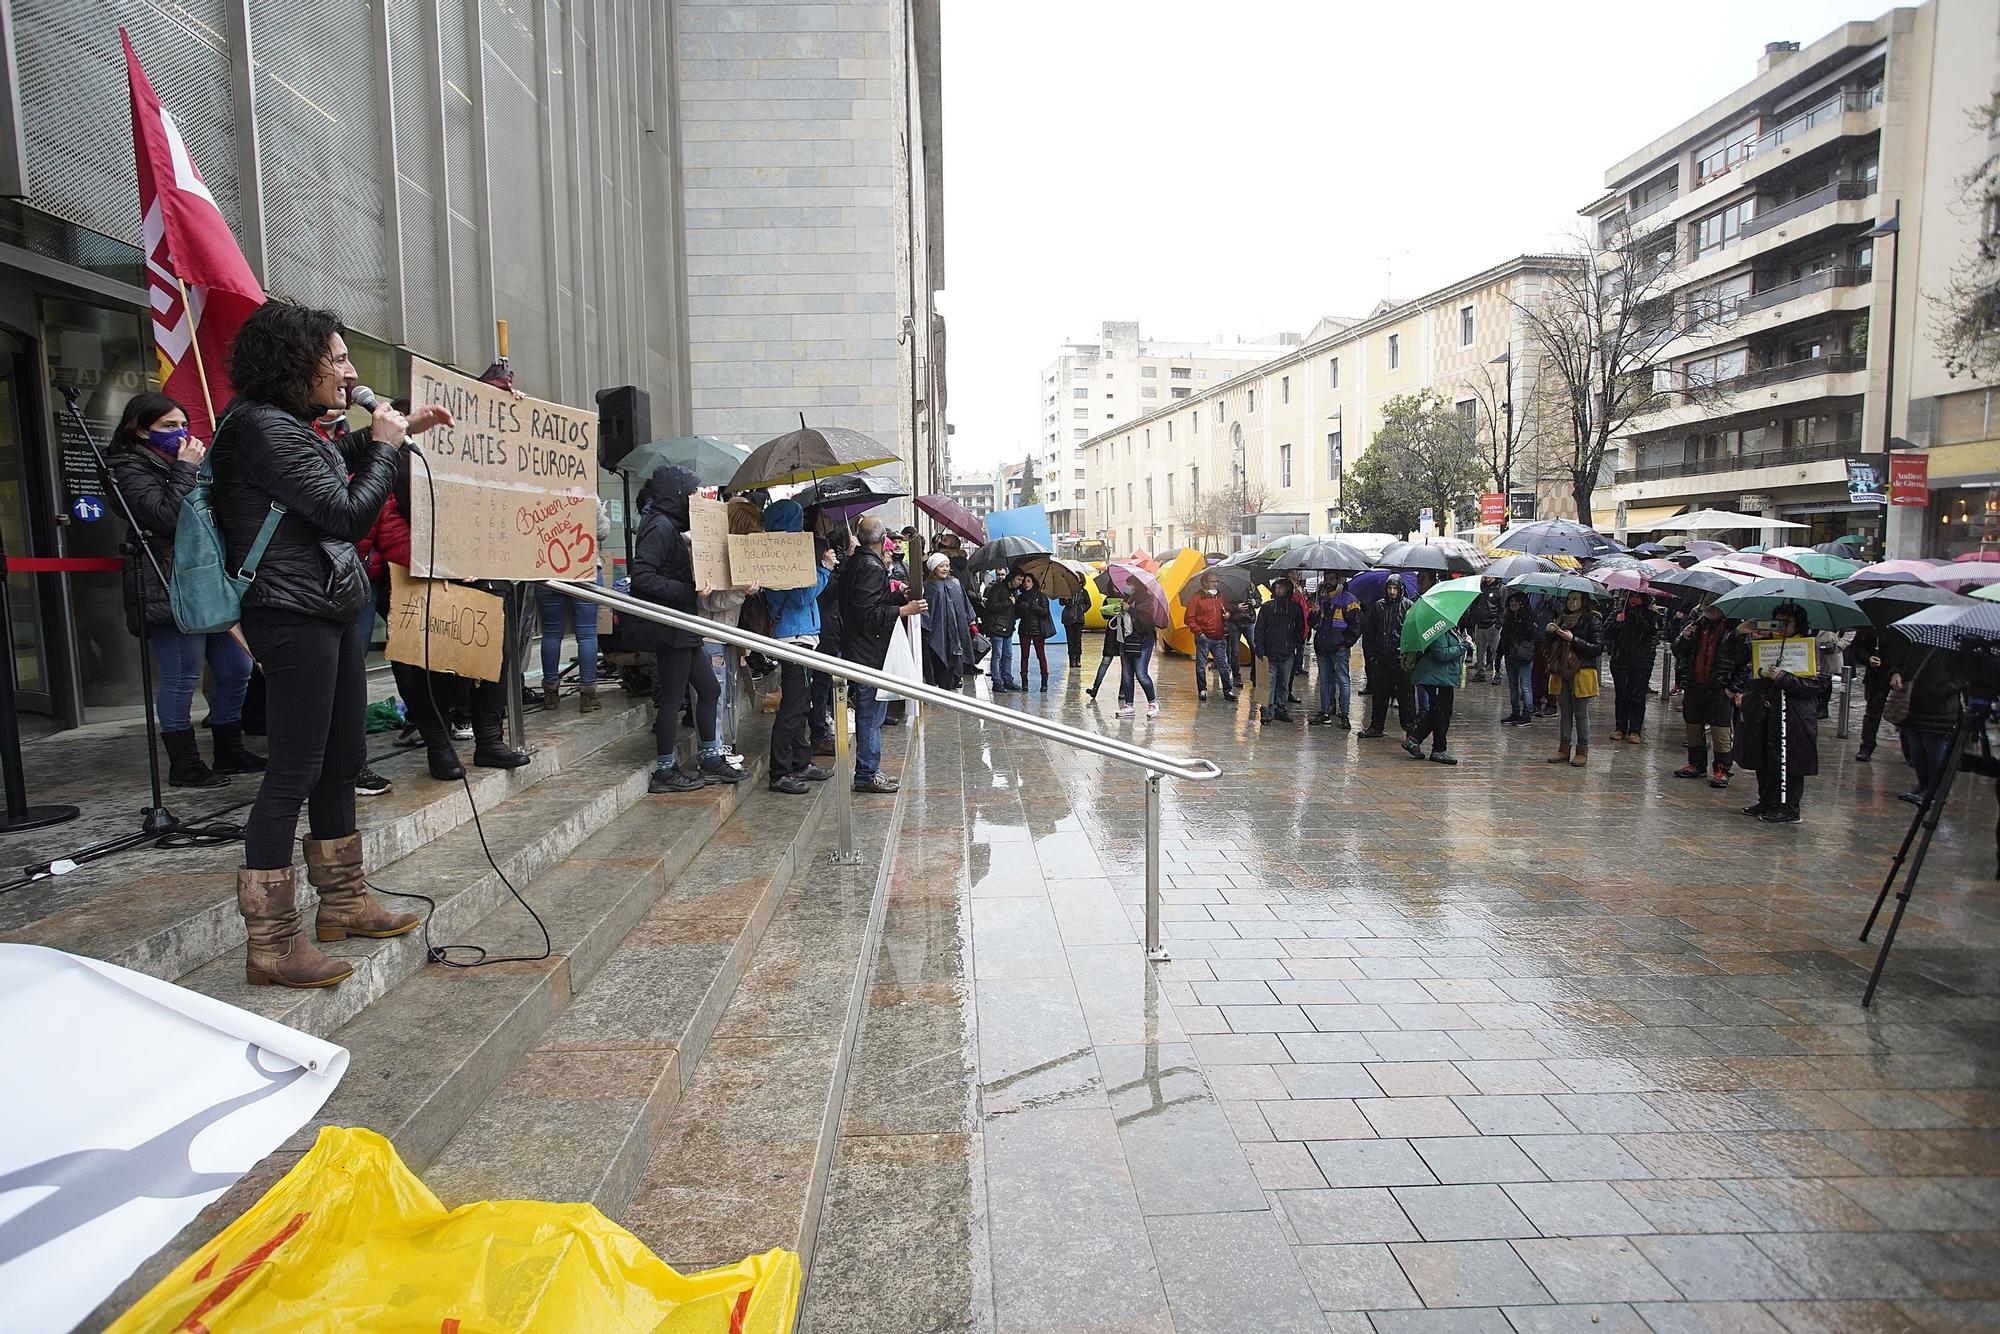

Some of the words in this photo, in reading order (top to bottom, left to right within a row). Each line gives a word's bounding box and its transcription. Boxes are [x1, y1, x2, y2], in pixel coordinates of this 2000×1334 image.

[423, 375, 478, 425] TENIM
[488, 399, 521, 433] LES
[531, 407, 589, 450] RÀTIOS
[461, 433, 508, 466] ALTES
[518, 442, 588, 480] D'EUROPA
[1896, 472, 1923, 480] Auditori
[535, 548, 546, 568] al
[547, 523, 595, 574] 0-3
[536, 512, 572, 544] també
